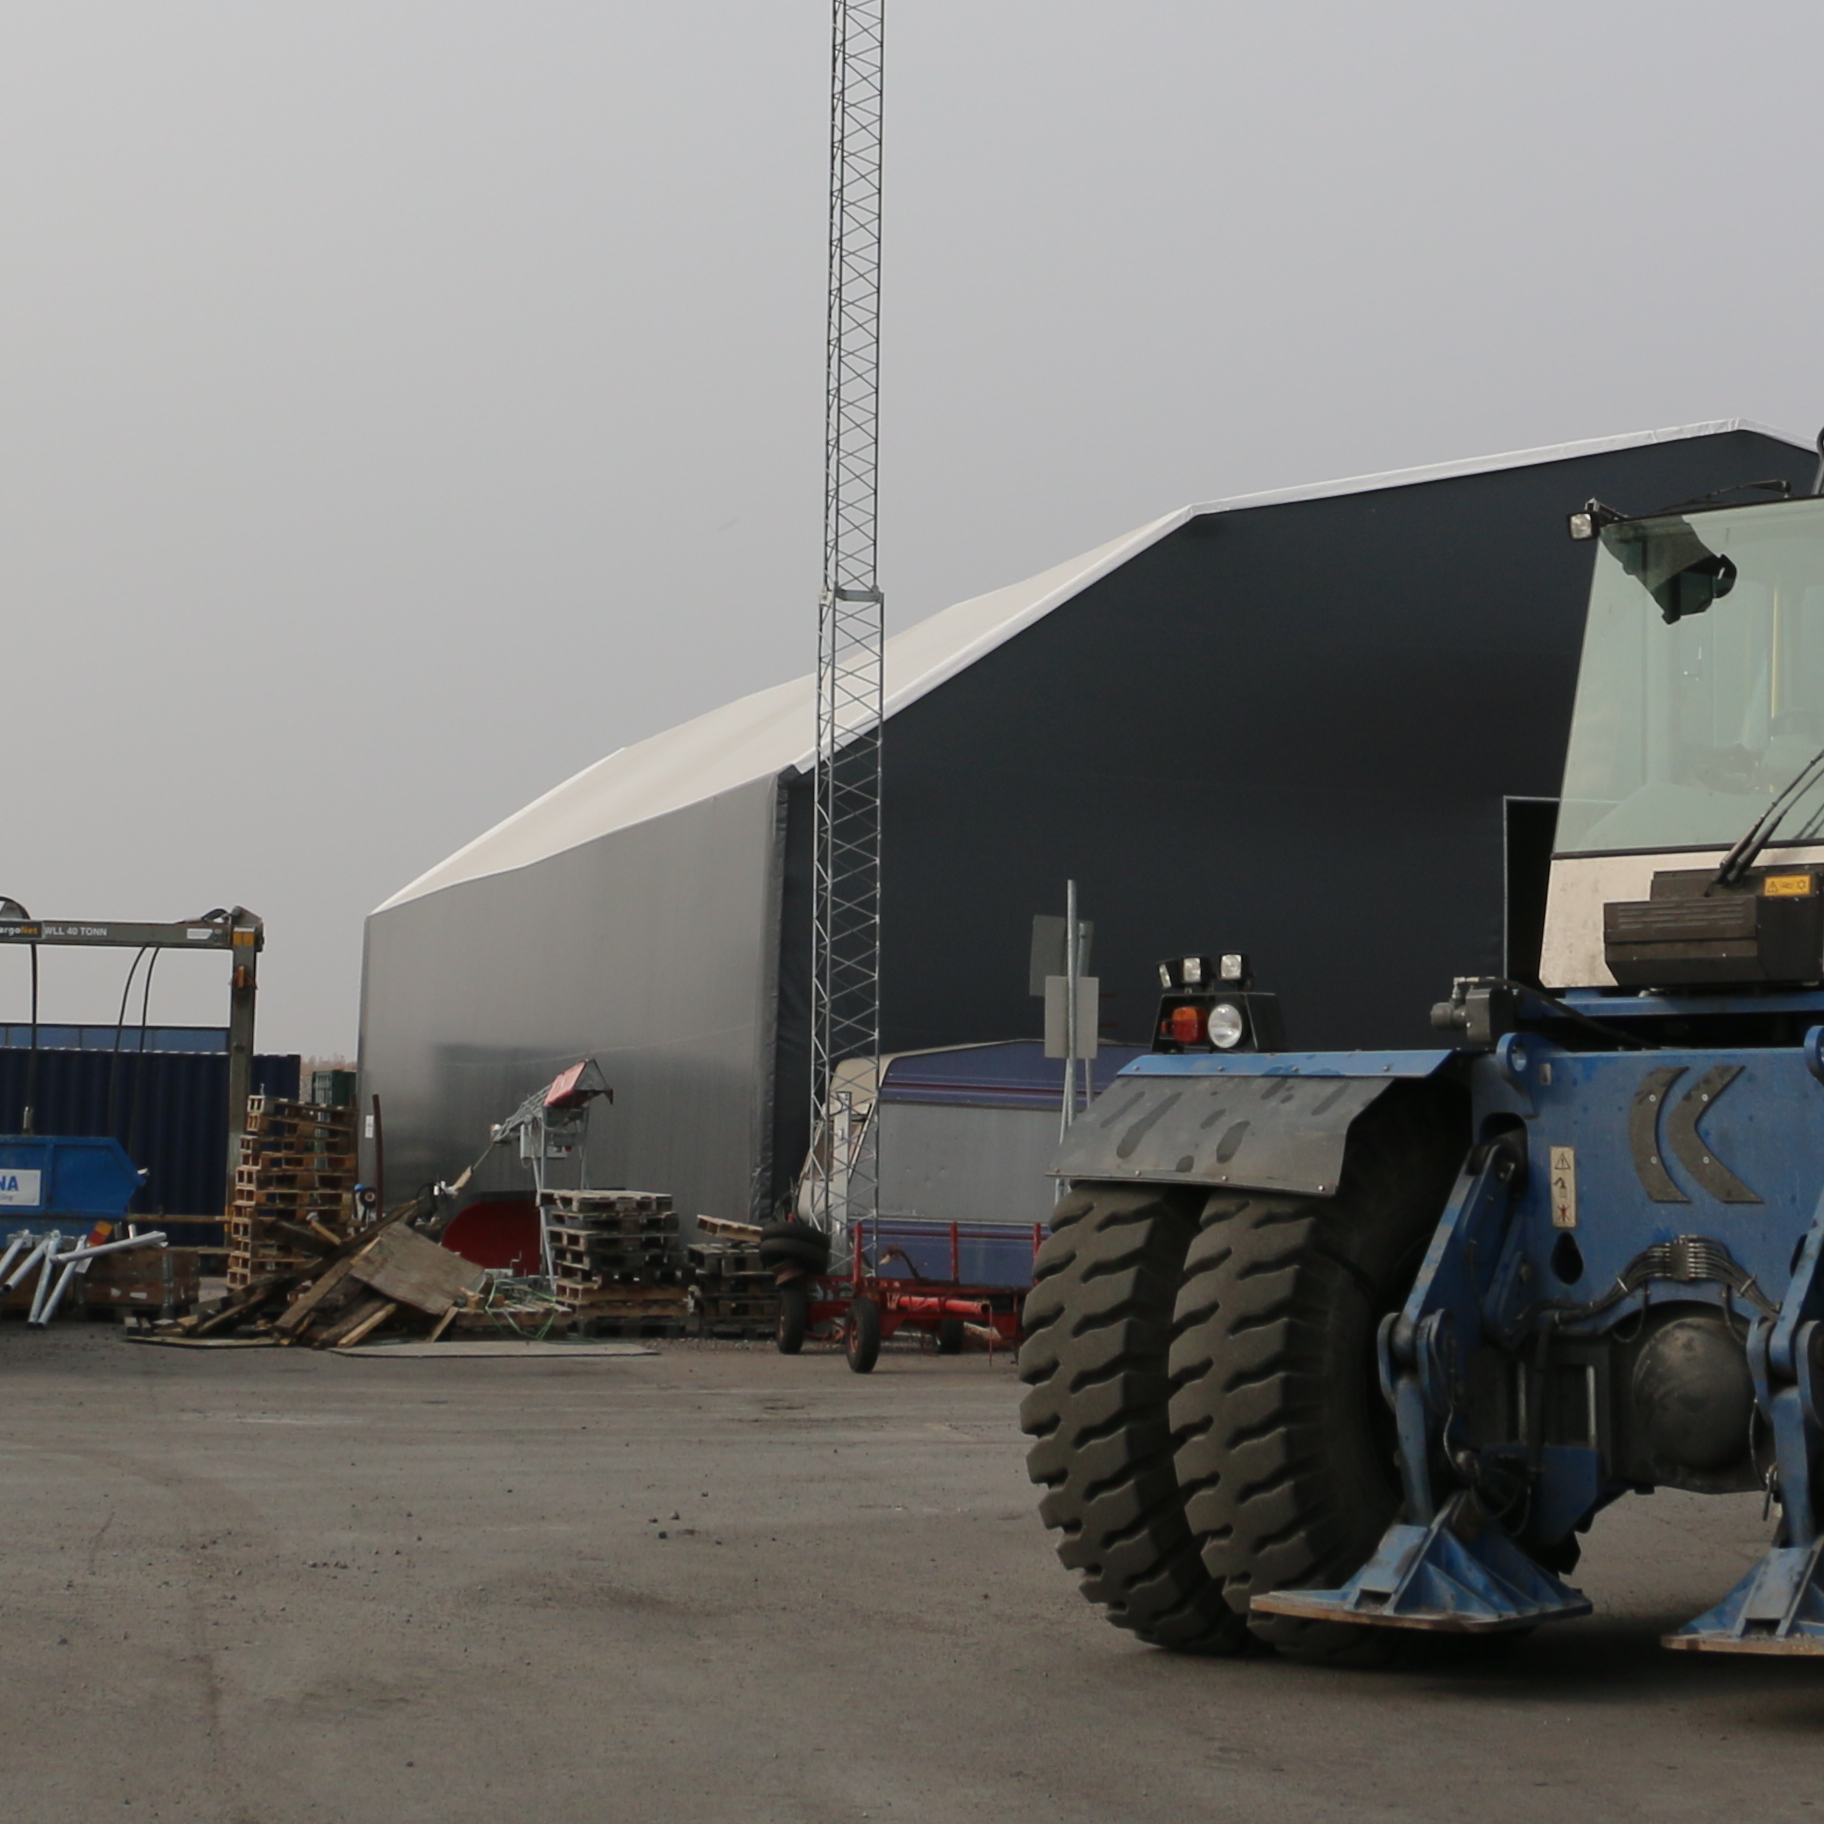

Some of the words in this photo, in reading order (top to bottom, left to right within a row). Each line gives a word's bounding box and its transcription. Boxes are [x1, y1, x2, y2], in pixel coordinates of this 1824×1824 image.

[44, 926, 64, 936] WLL
[66, 926, 78, 936] 40
[80, 927, 108, 937] TONN
